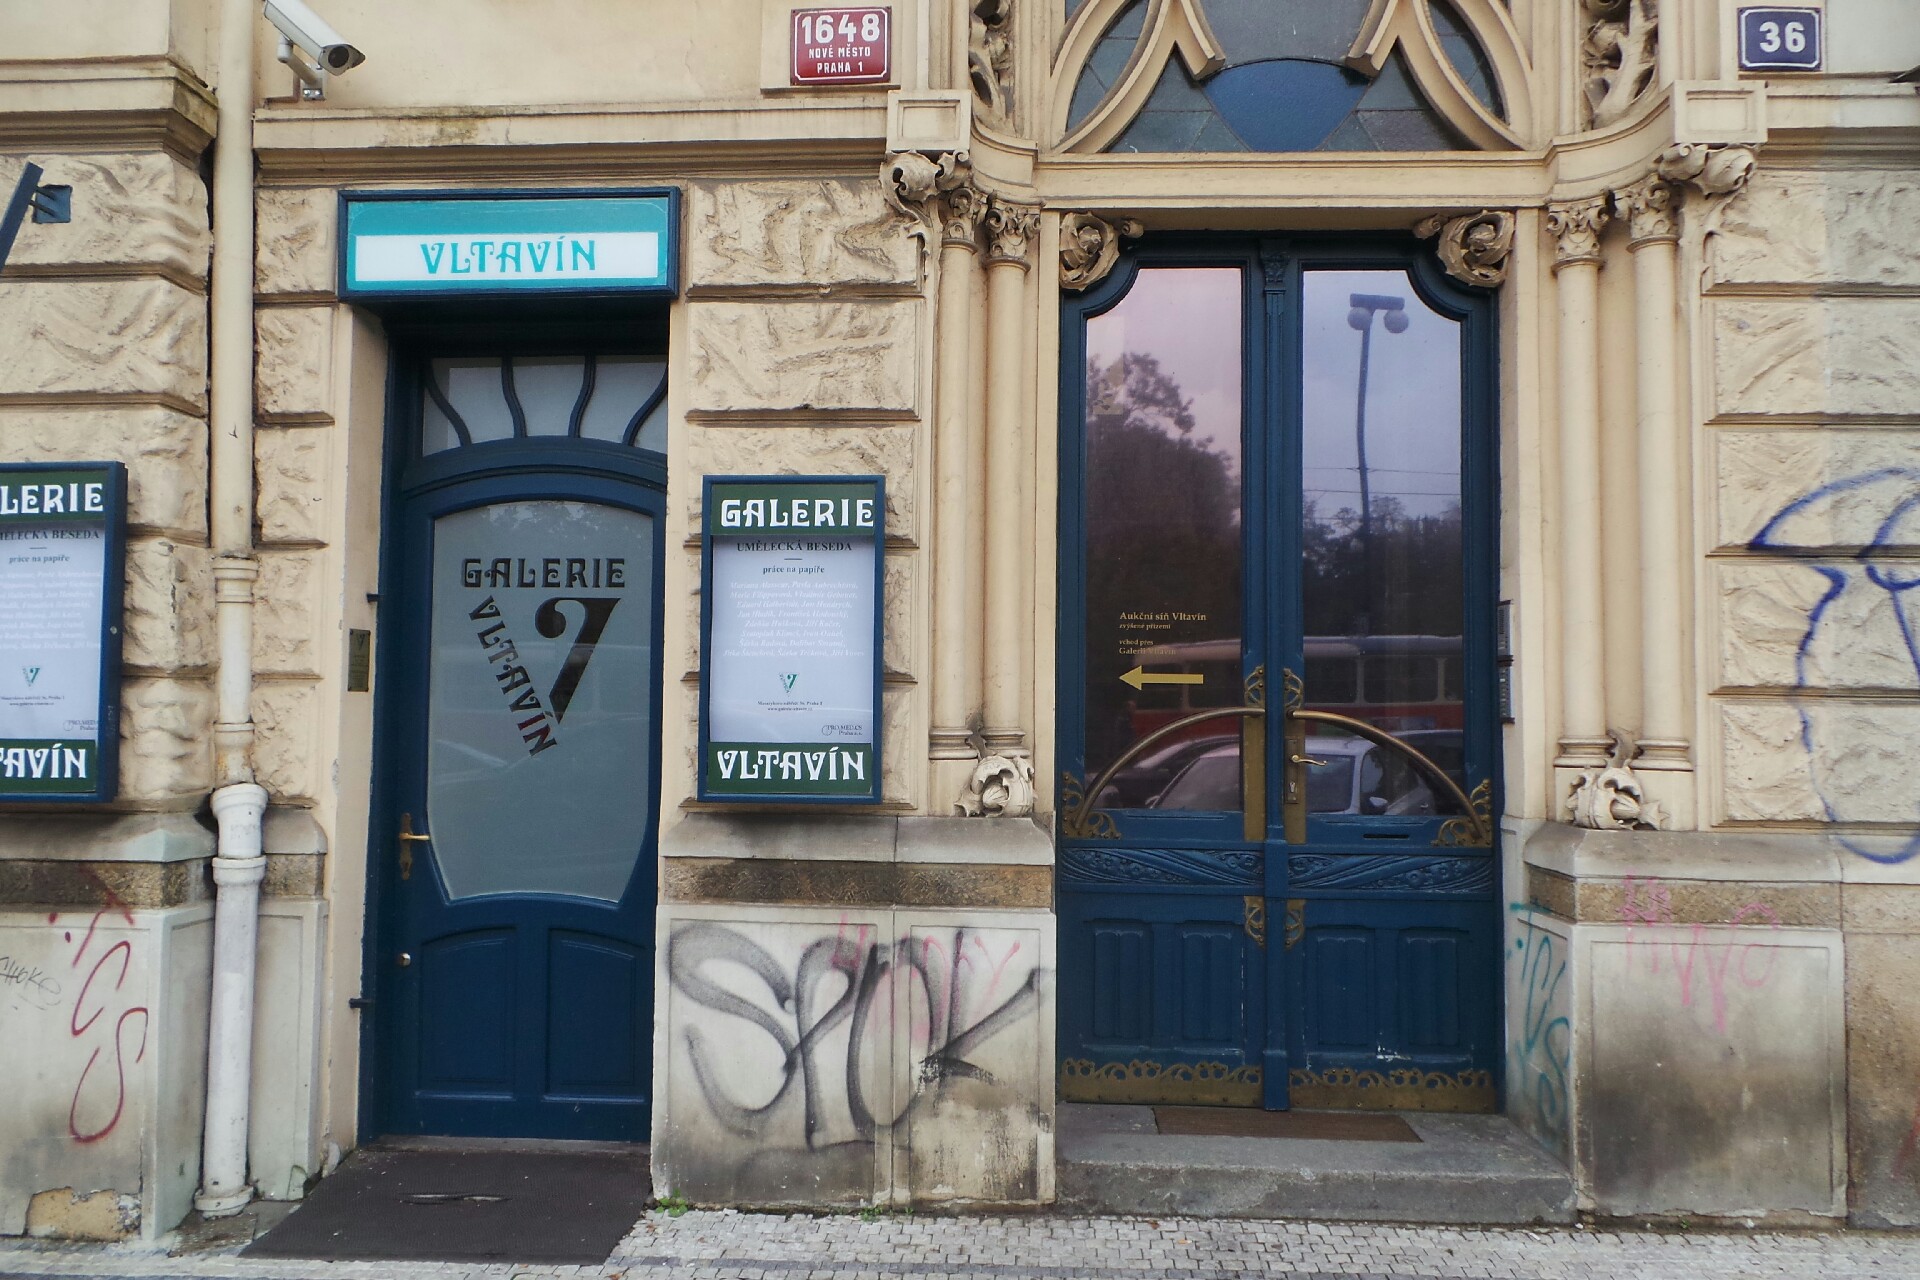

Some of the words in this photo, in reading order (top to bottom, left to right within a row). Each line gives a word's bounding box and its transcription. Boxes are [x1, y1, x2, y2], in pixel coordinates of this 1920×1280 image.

[801, 13, 880, 44] 1648
[1759, 21, 1806, 53] 36
[808, 45, 834, 58] NOVÉ
[838, 44, 871, 58] MĚSTO
[817, 62, 851, 74] PRAHA
[858, 61, 863, 72] 1
[420, 235, 596, 274] VLTAVÍN
[720, 498, 874, 528] GALERIE
[52, 530, 100, 540] BESEDA
[736, 540, 803, 551] UMĚLECKÁ
[806, 542, 852, 551] BESEDA
[9, 554, 31, 564] práce
[43, 554, 70, 564] papíře
[461, 557, 625, 588] GALERIE
[763, 565, 785, 575] práce
[798, 565, 825, 575] papíře
[1119, 611, 1153, 620] Aukční
[1155, 612, 1170, 620] síň
[1172, 612, 1207, 621] Vltavín
[1119, 638, 1139, 646] vchod
[1139, 639, 1154, 647] přes
[468, 595, 558, 757] VLTAVÍN
[716, 745, 865, 781] VLTAVÍN
